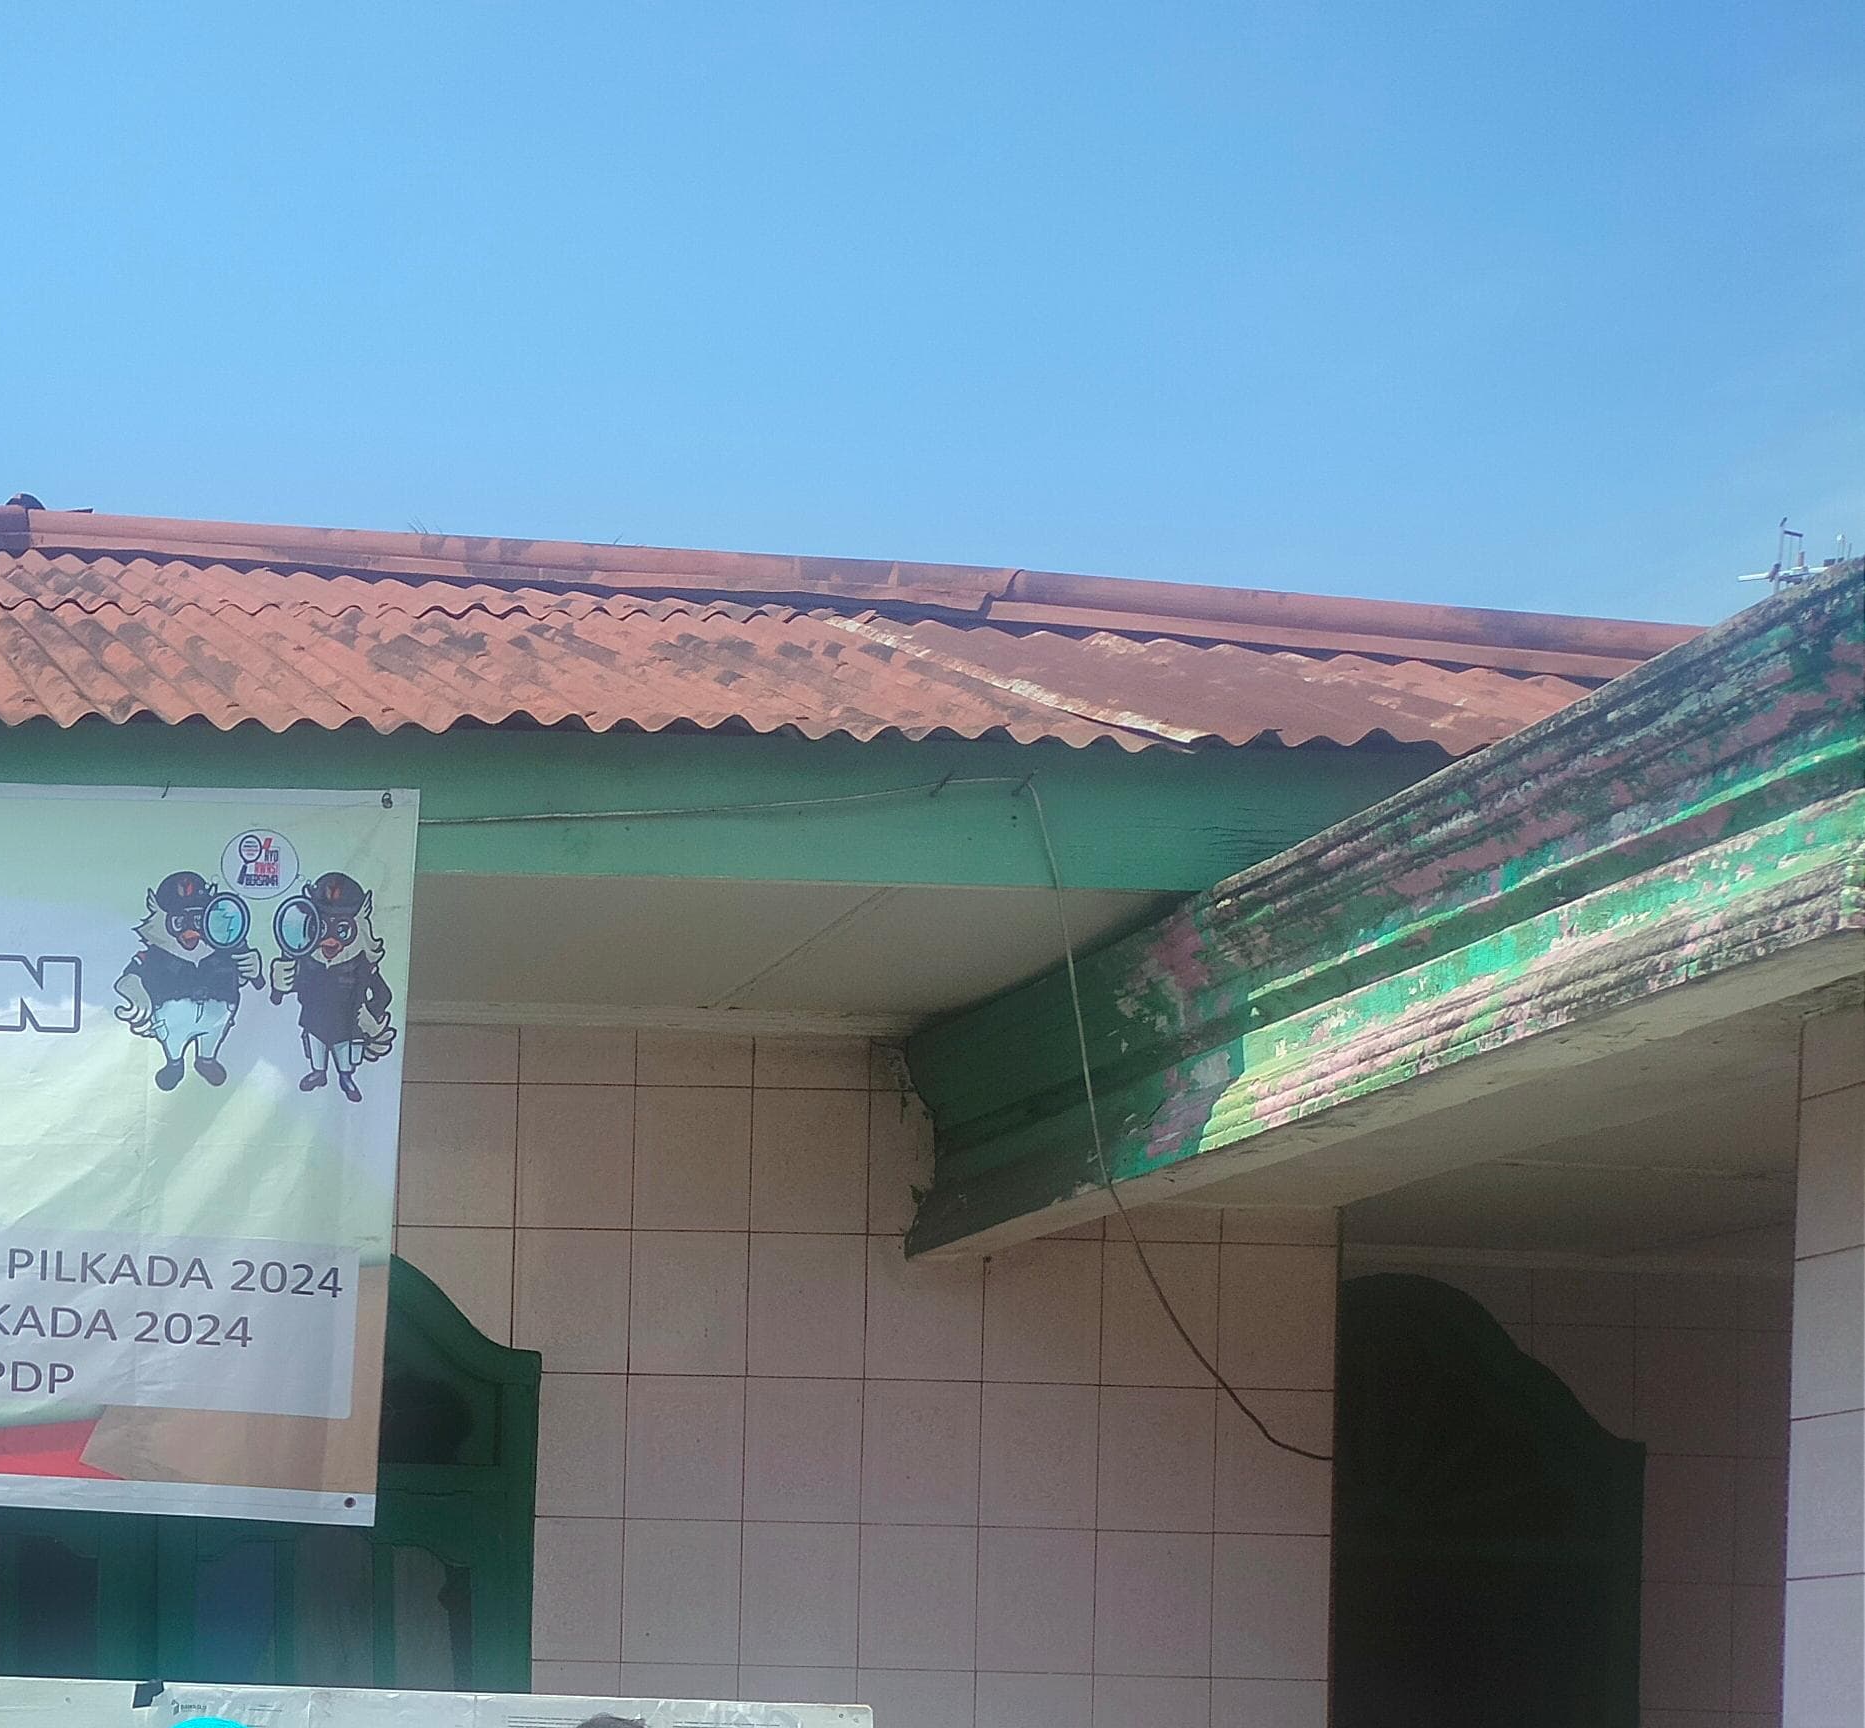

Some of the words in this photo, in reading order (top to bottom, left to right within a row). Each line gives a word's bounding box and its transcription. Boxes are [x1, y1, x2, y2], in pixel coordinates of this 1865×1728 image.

[6, 1246, 214, 1292] PILKADA
[230, 1257, 344, 1299] 2024
[134, 1310, 254, 1349] 2024
